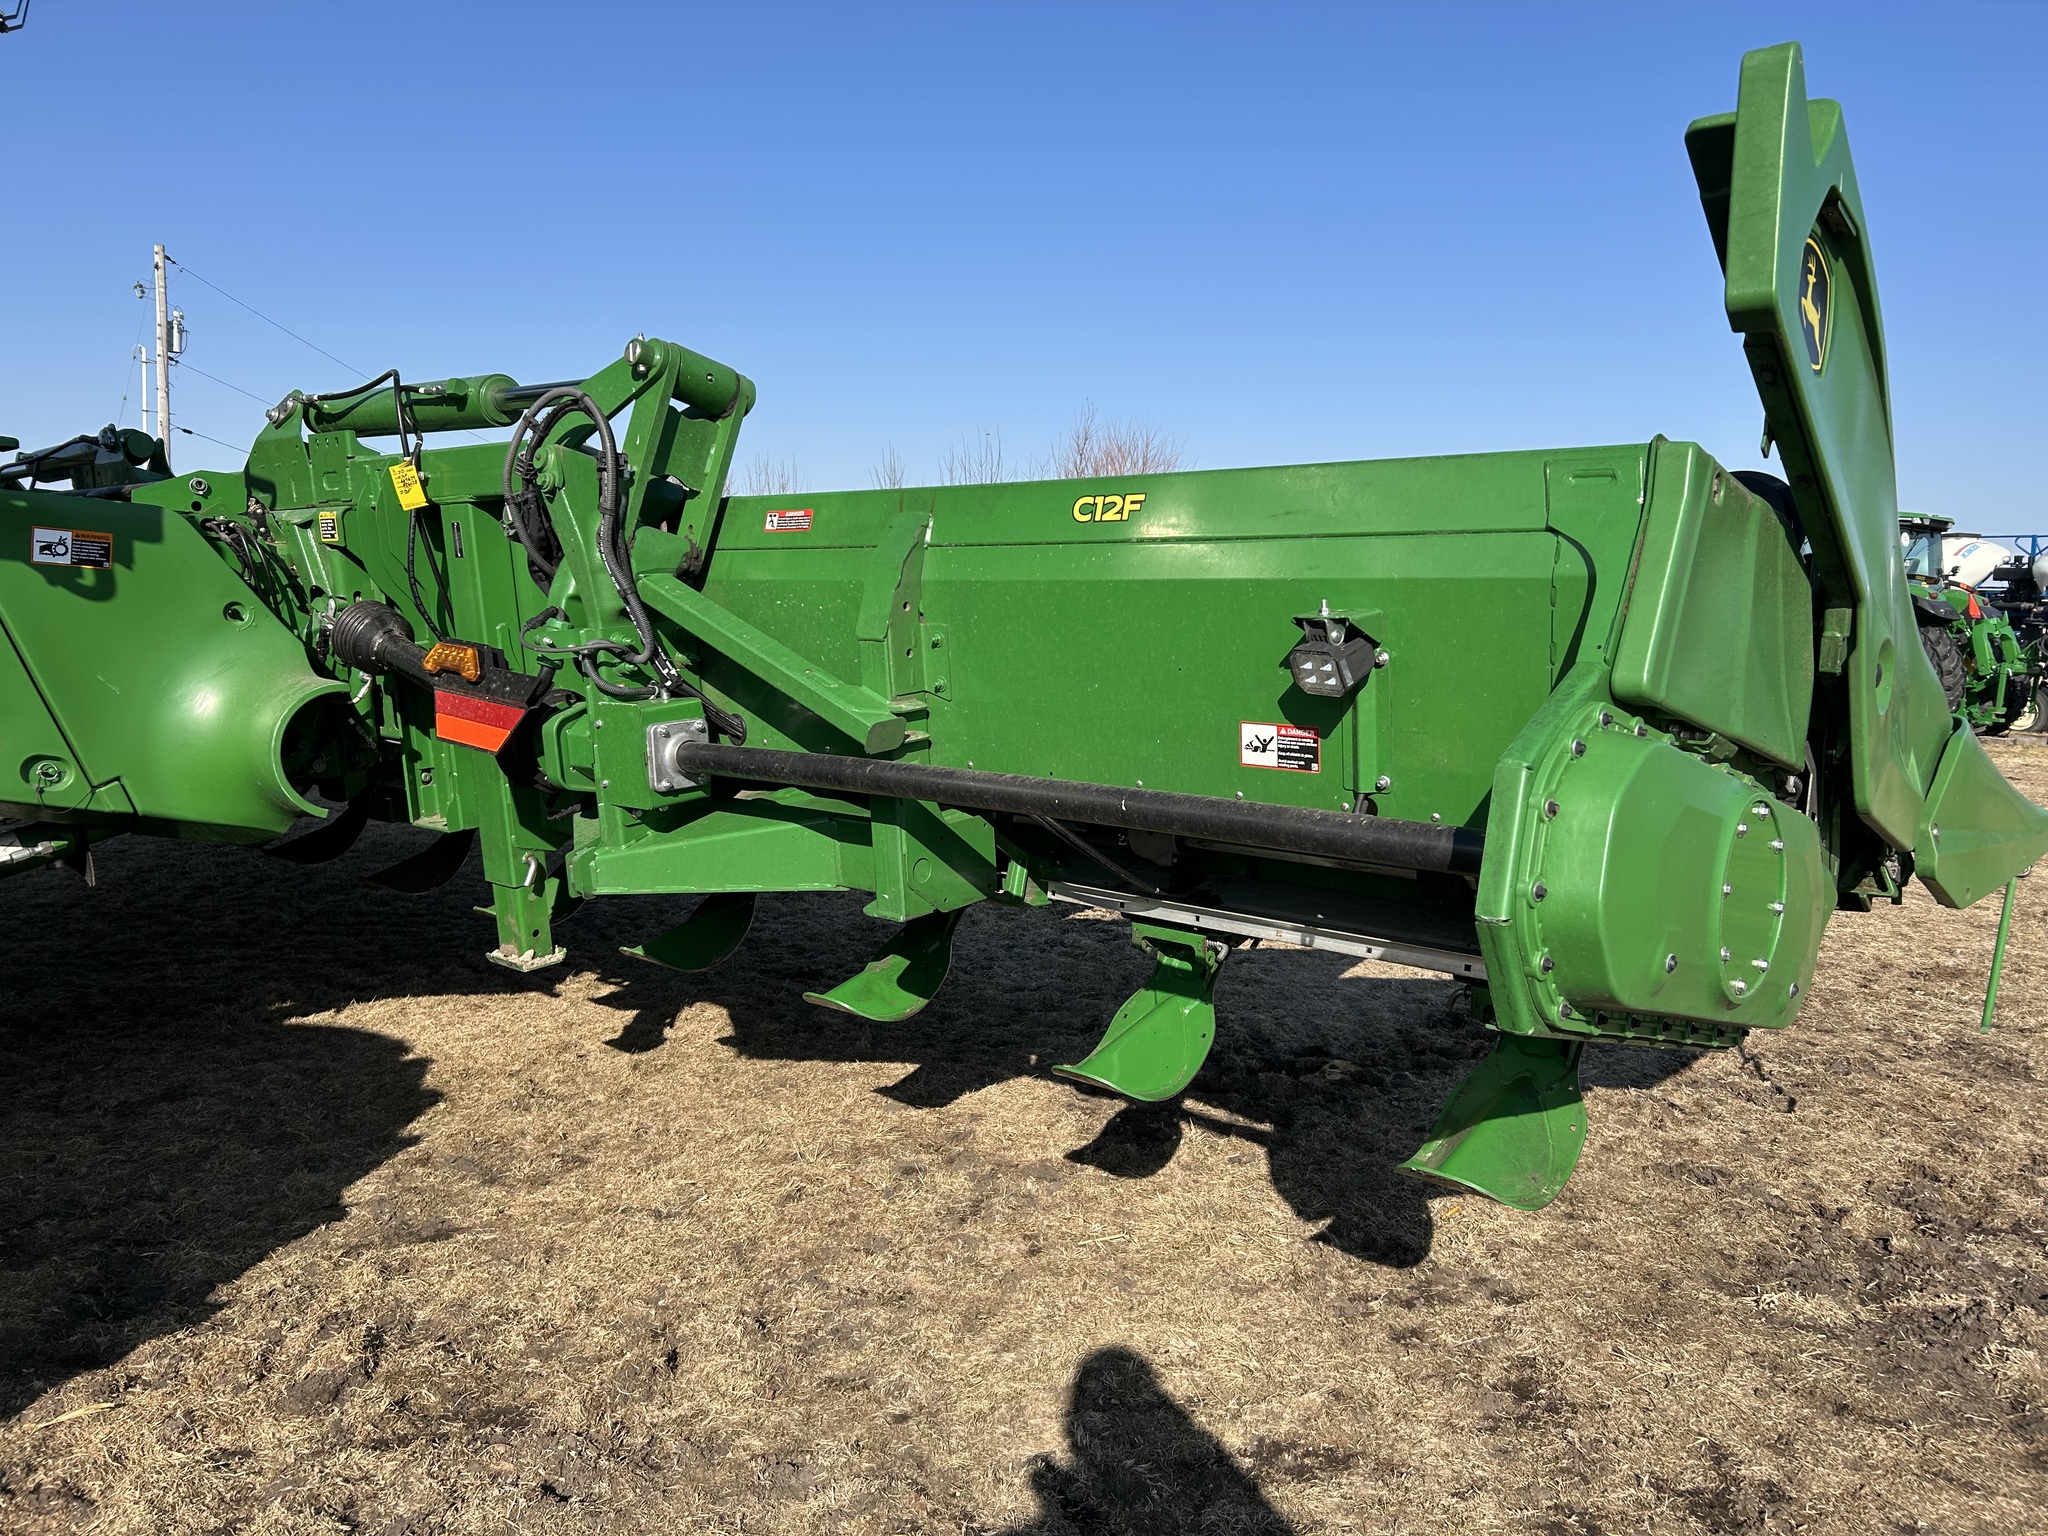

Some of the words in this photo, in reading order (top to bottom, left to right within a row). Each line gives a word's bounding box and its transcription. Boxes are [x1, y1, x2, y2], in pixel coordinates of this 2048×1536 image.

[1072, 493, 1147, 523] C12F
[80, 533, 110, 541] WARNING
[1287, 728, 1315, 737] DANGER
